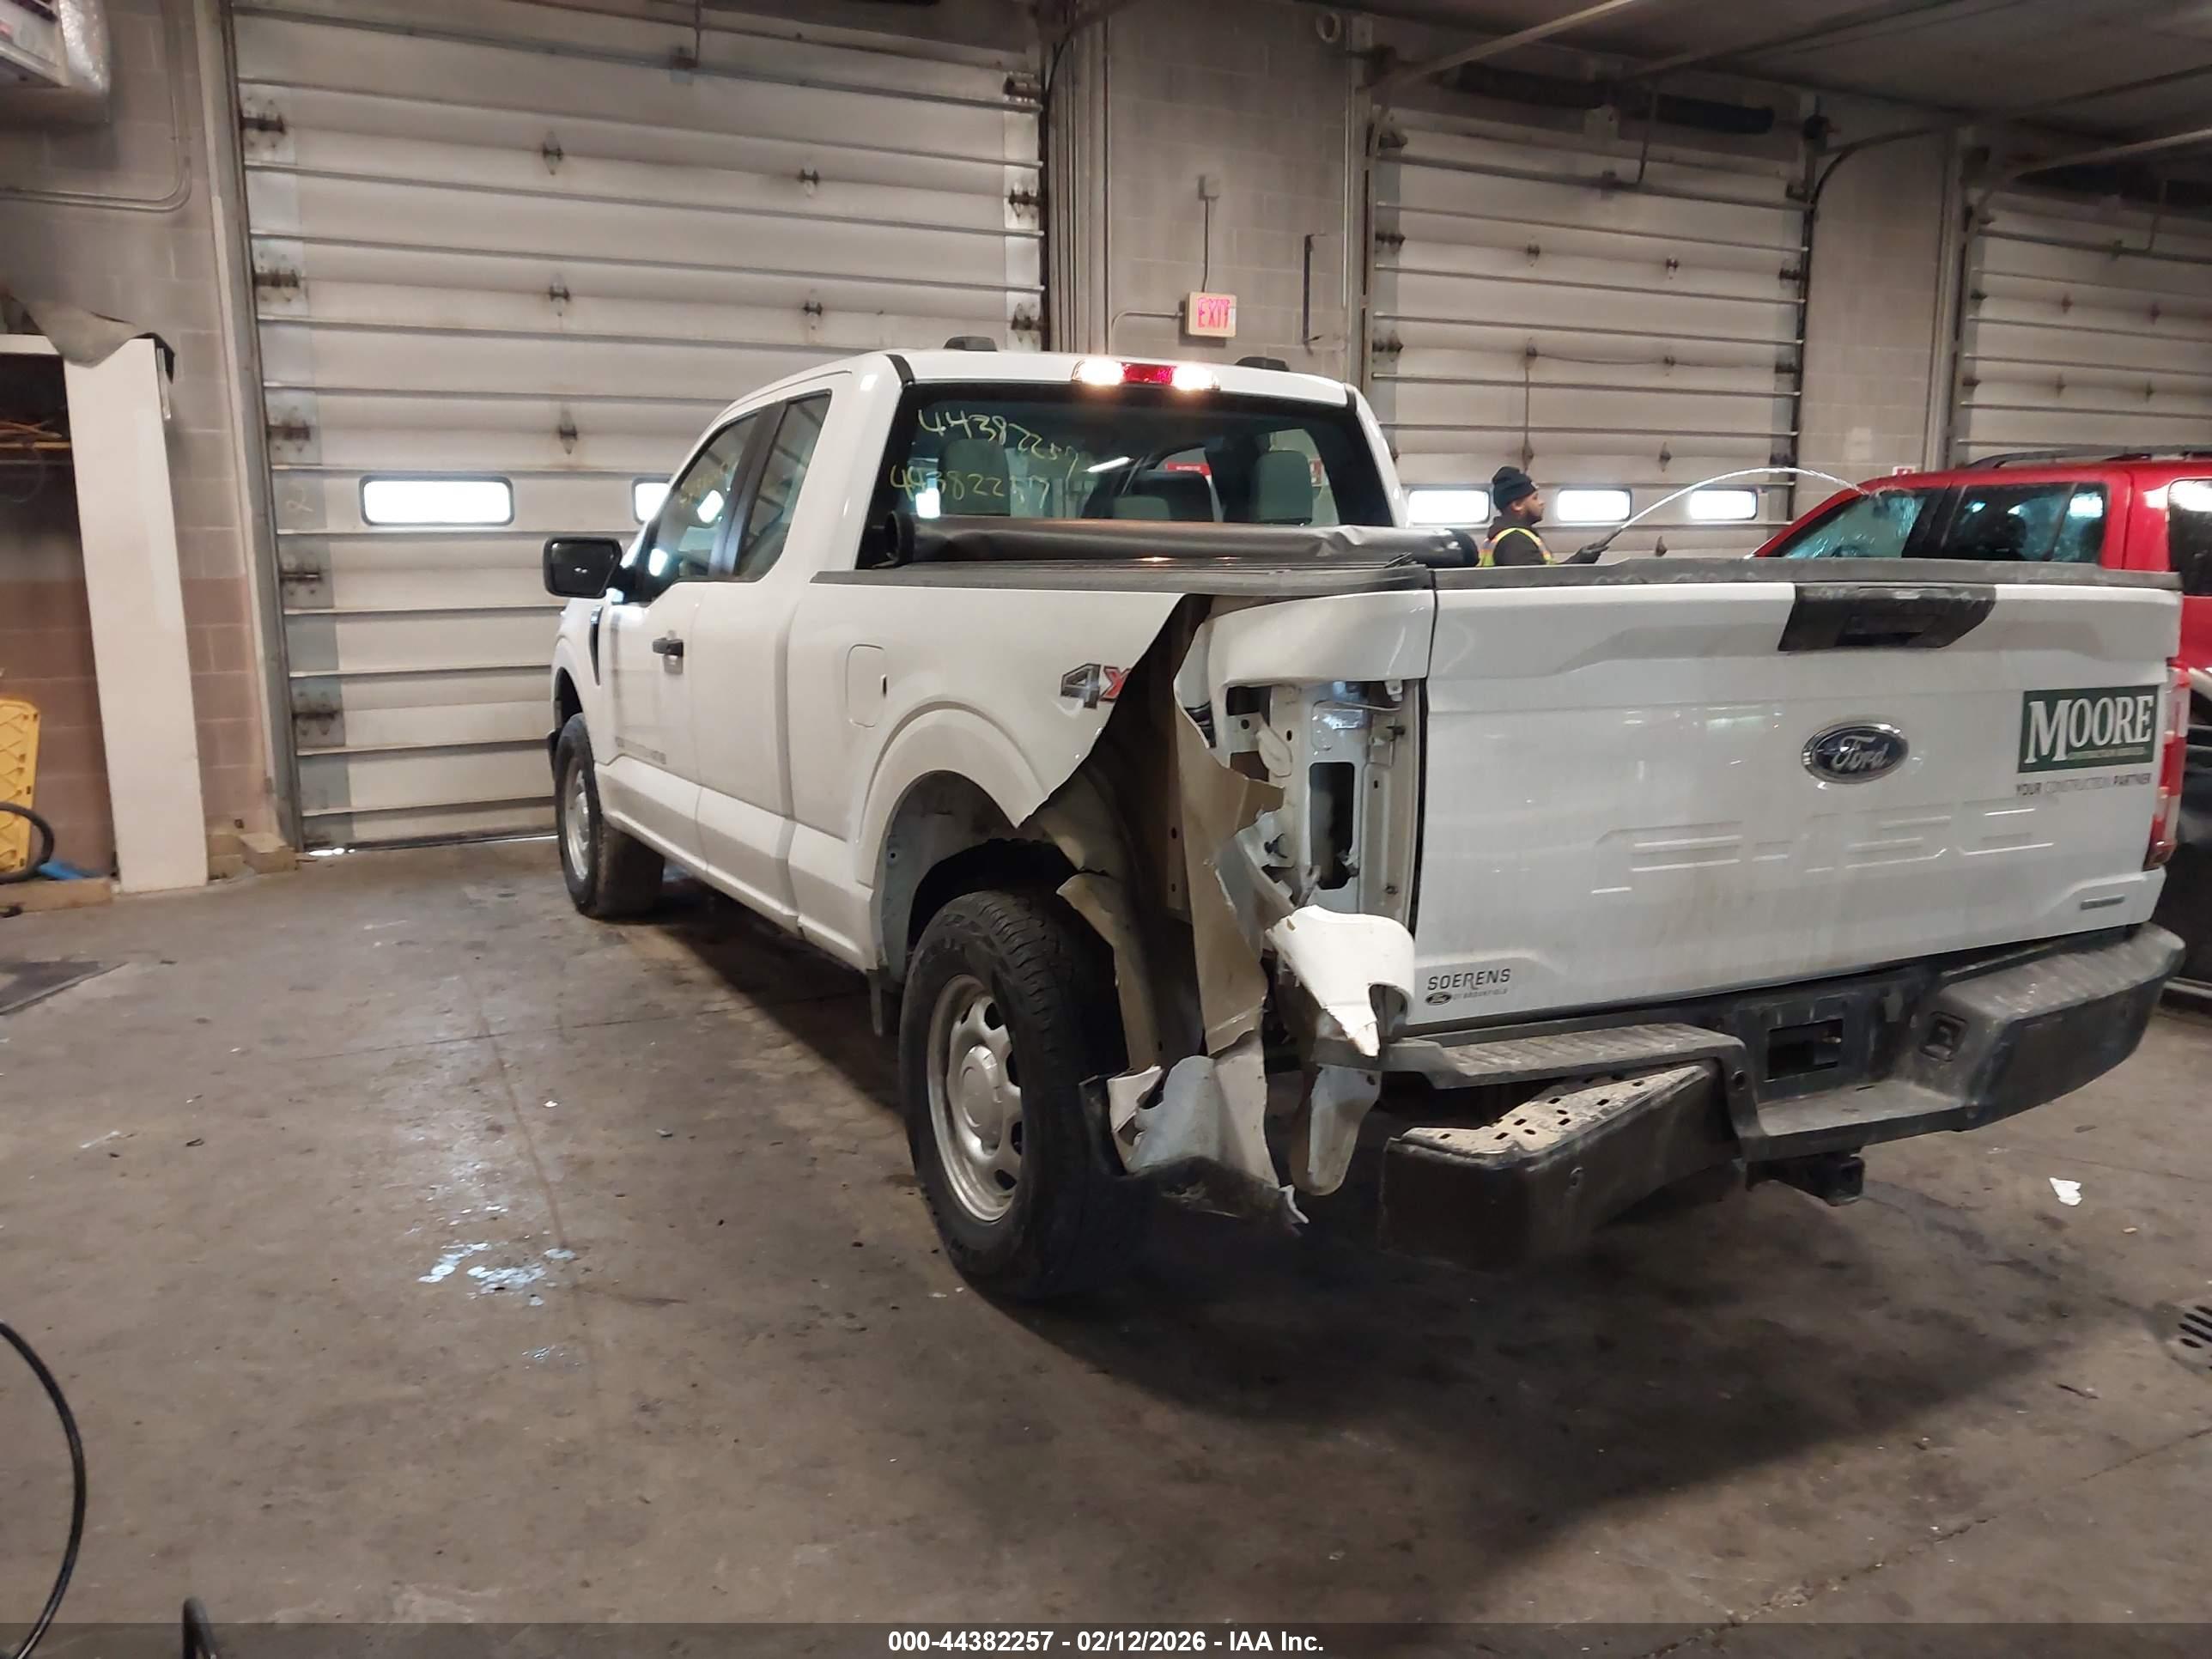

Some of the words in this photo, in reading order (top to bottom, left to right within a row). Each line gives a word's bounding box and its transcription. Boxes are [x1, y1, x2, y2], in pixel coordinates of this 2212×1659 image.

[1197, 296, 1230, 329] EXIT
[918, 409, 1079, 481] 44382257
[2025, 696, 2154, 764] MOORE
[1832, 735, 1890, 771] Ford
[2016, 782, 2042, 796] YOUR
[2113, 773, 2151, 786] PARTNER
[1428, 969, 1511, 990] SOERENS
